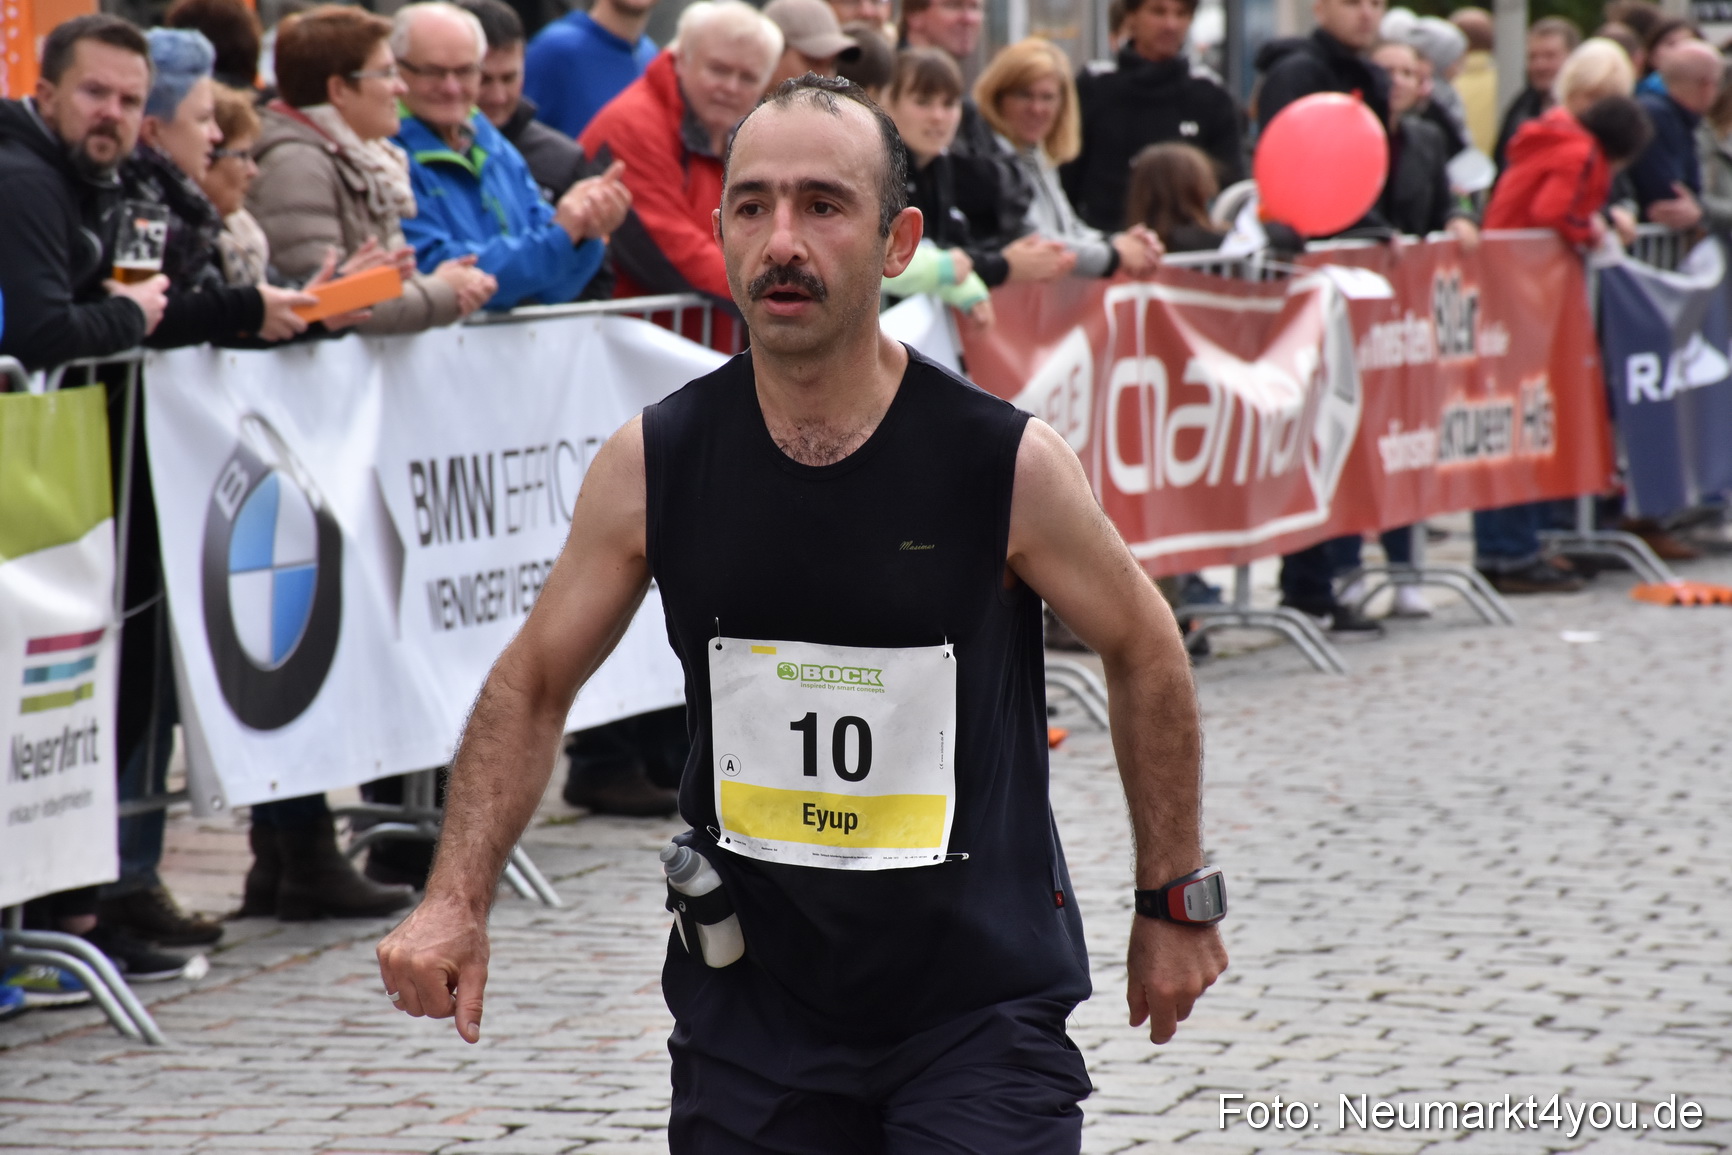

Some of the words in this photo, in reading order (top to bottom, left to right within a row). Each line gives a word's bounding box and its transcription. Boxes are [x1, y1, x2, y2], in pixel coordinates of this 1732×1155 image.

[409, 453, 497, 548] BMW
[800, 682, 827, 690] inspired
[828, 683, 836, 691] by
[856, 686, 886, 694] concepts
[801, 664, 884, 687] BOCK
[790, 712, 873, 782] 10
[726, 759, 735, 771] A
[803, 803, 859, 835] Eyup
